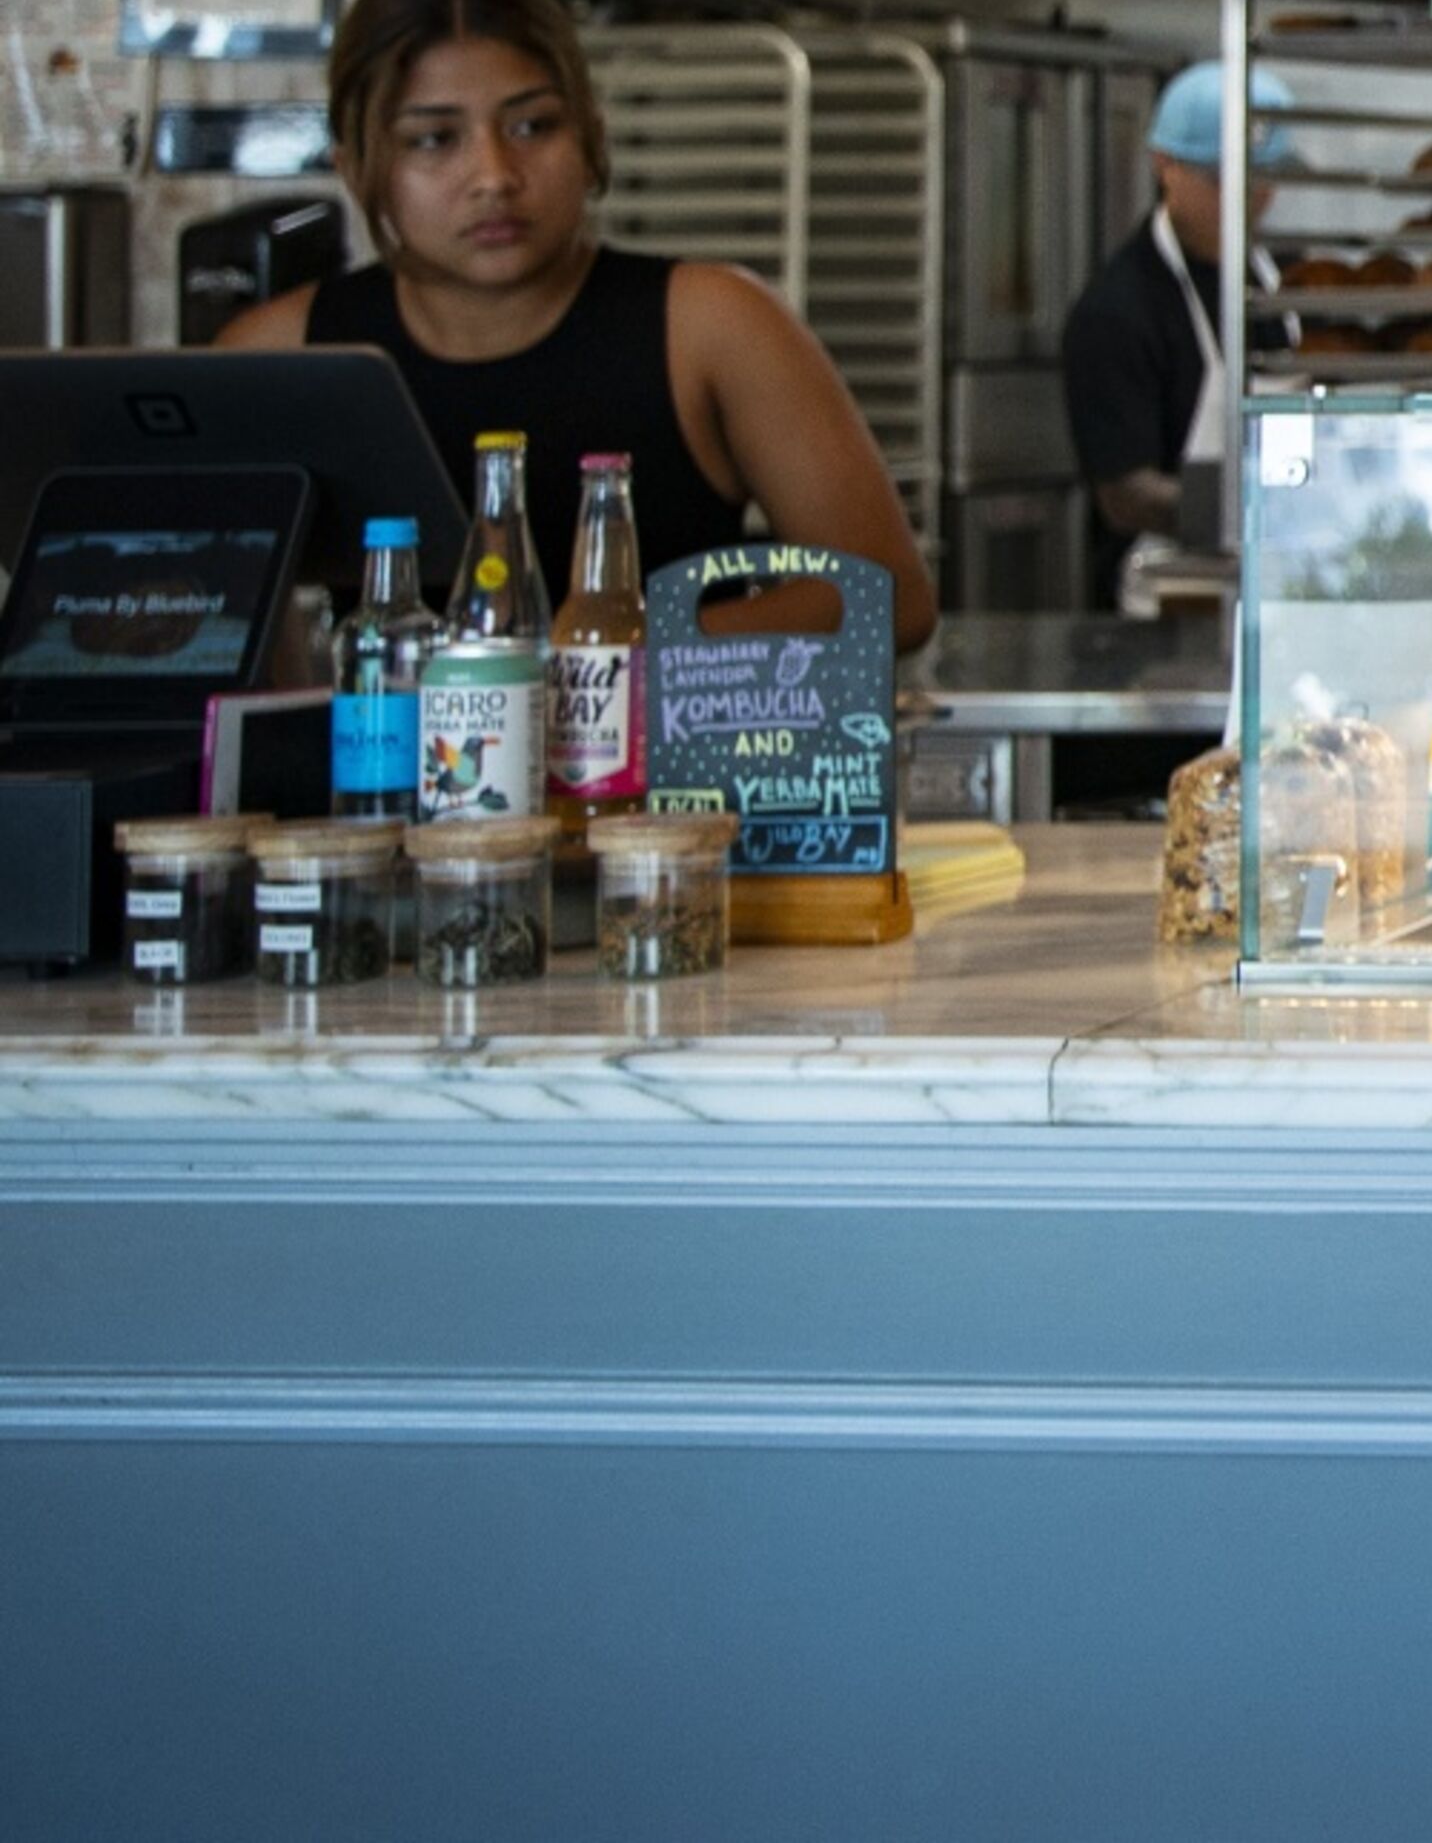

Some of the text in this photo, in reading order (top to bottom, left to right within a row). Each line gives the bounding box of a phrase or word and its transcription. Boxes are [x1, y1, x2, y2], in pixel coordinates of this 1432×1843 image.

[702, 546, 829, 585] ALL NEW
[115, 592, 138, 618] By
[145, 591, 226, 615] Bluebird
[659, 642, 770, 669] STRAWBERRY
[425, 689, 508, 719] ICARO
[661, 687, 825, 743] KOMBUCHA
[735, 729, 794, 757] AND
[812, 752, 882, 777] MINT
[733, 776, 882, 817] YERBA MATE
